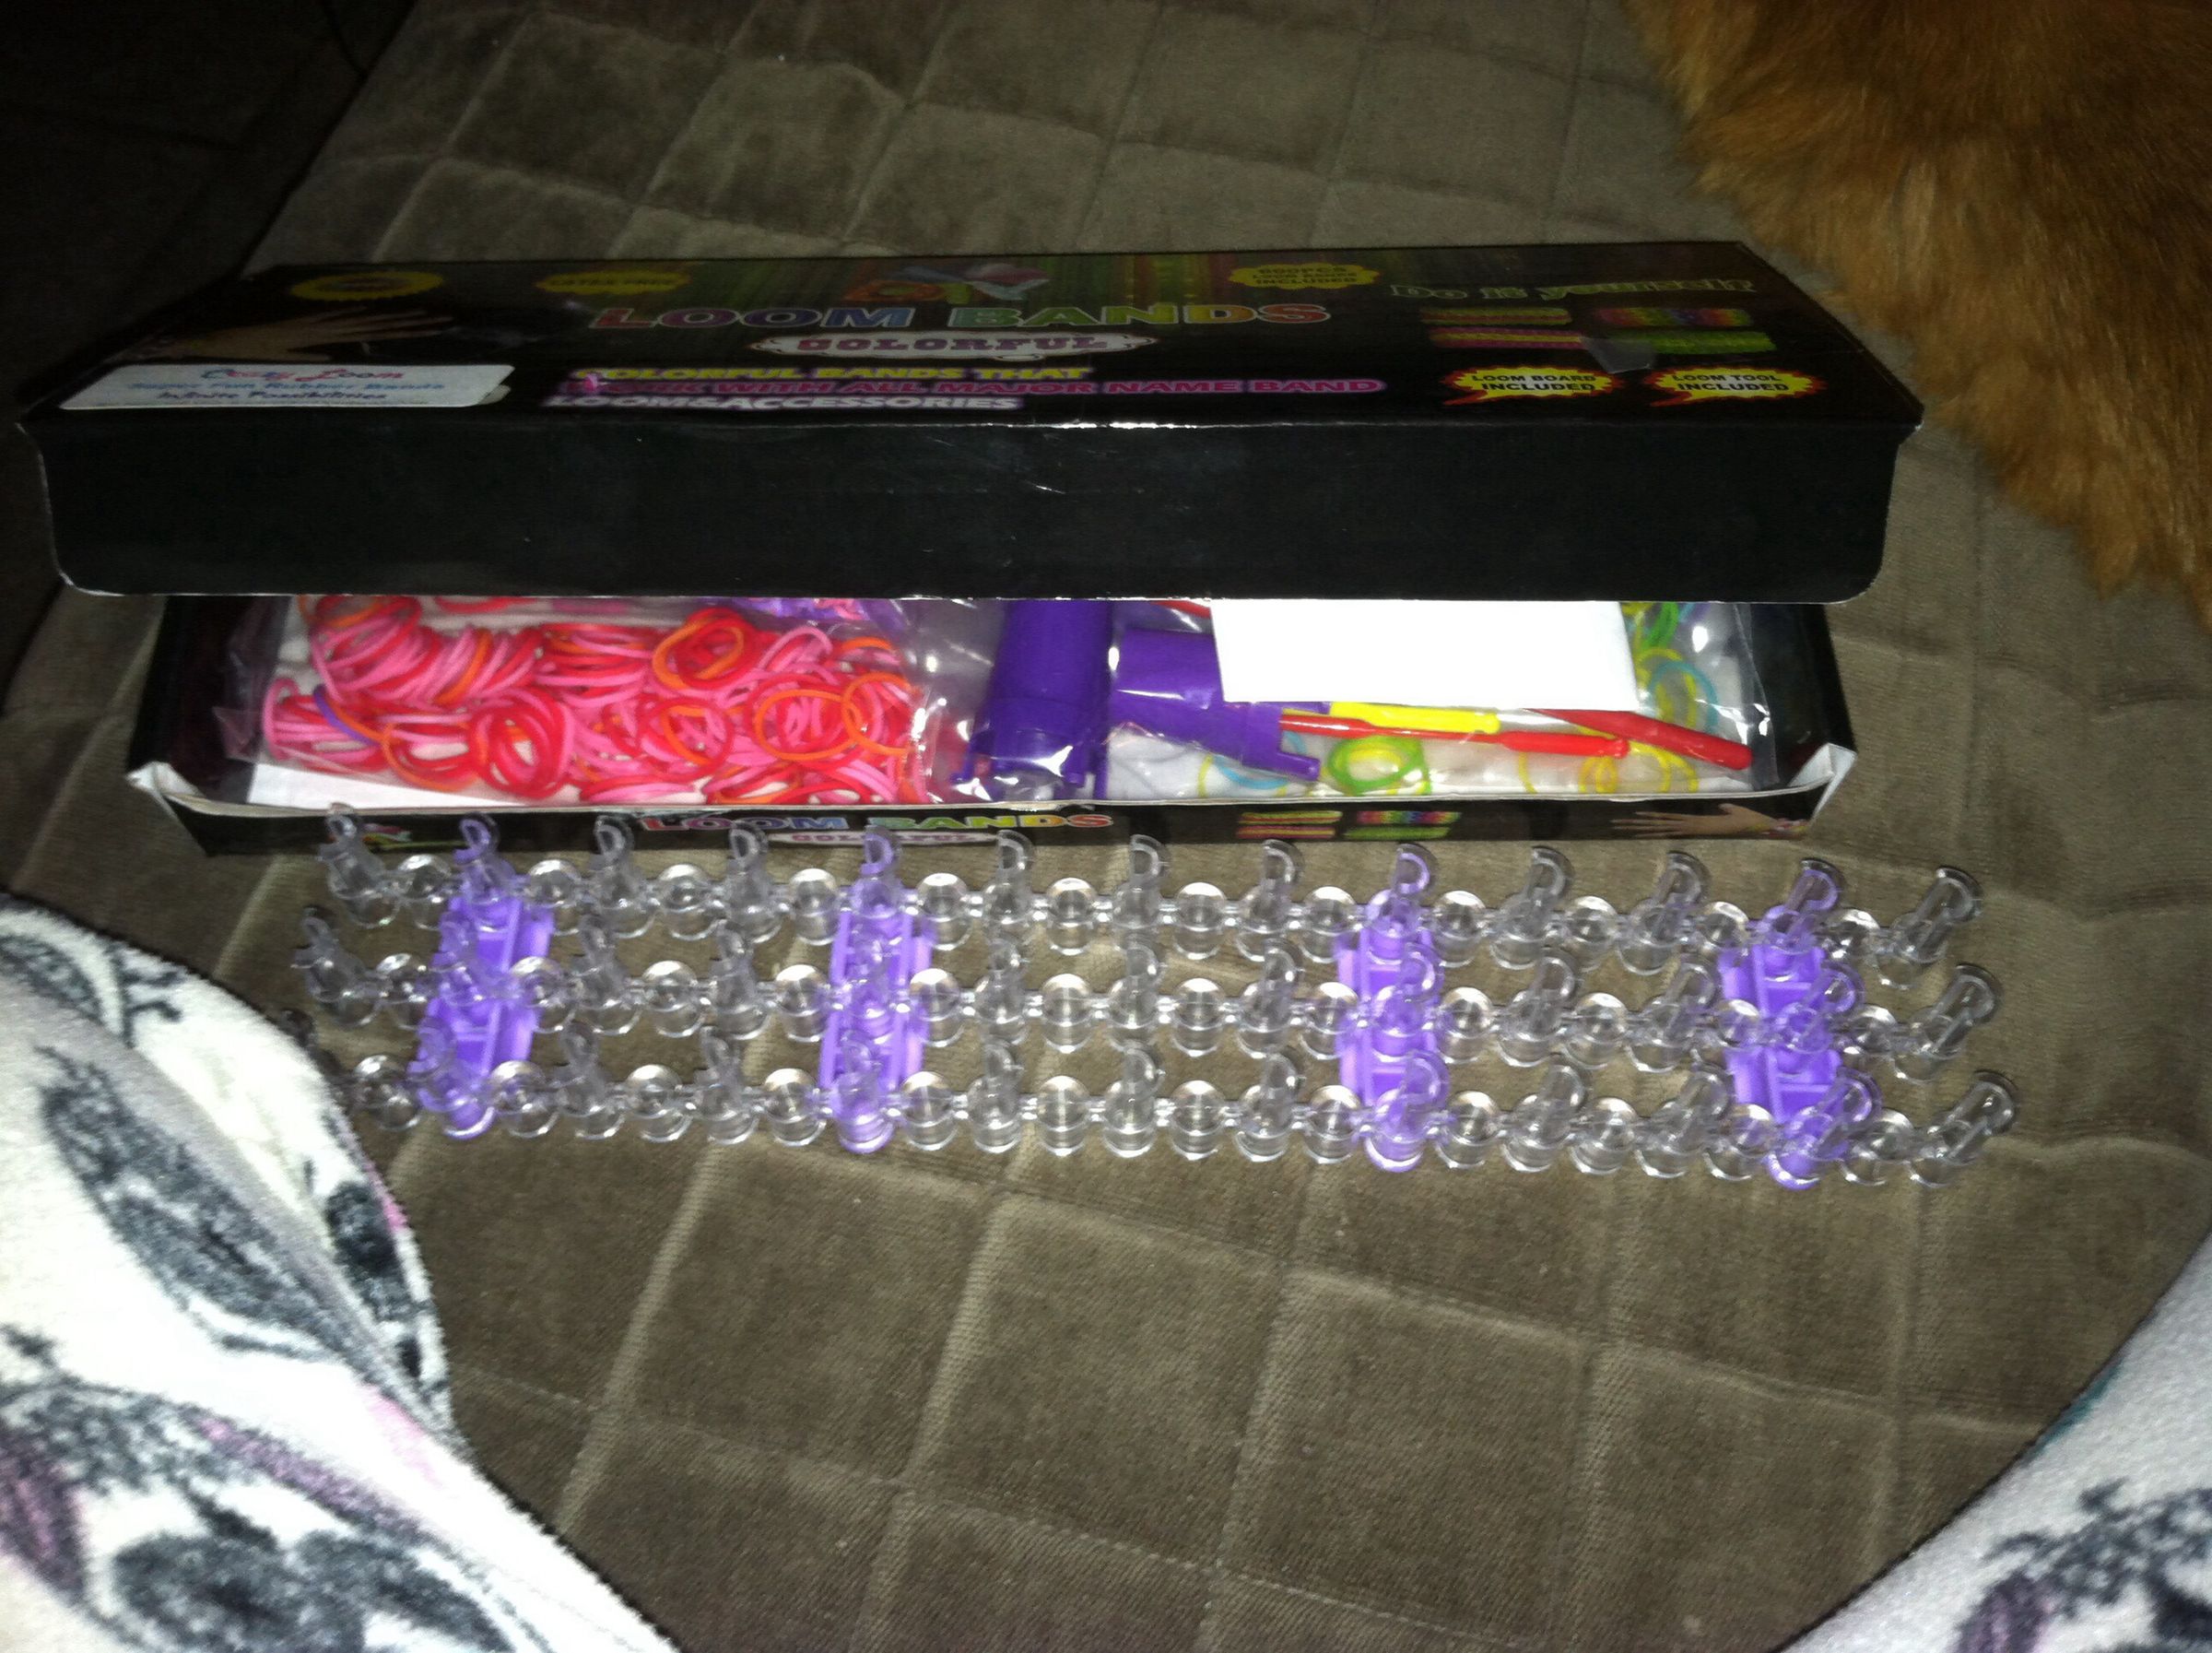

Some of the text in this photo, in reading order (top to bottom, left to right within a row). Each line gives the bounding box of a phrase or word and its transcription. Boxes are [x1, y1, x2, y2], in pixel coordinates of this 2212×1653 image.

[589, 303, 1331, 328] LOOM BANDS
[797, 337, 1106, 351] COLORFUL
[571, 368, 1092, 380] COLORFUL BANDS THAT
[1472, 373, 1596, 383] LOOM BOARD
[1672, 373, 1782, 382] LOOM TOOL
[712, 382, 834, 394] WITH
[839, 382, 927, 394] ALL
[932, 383, 1097, 395] MAJOR
[1104, 381, 1241, 395] NAME
[1245, 379, 1384, 394] BAND
[1481, 382, 1595, 392] INCLUDED
[1677, 382, 1790, 392] INCLUDED
[639, 813, 1112, 832] LOOM BANDS
[791, 833, 975, 843] COLFUL
